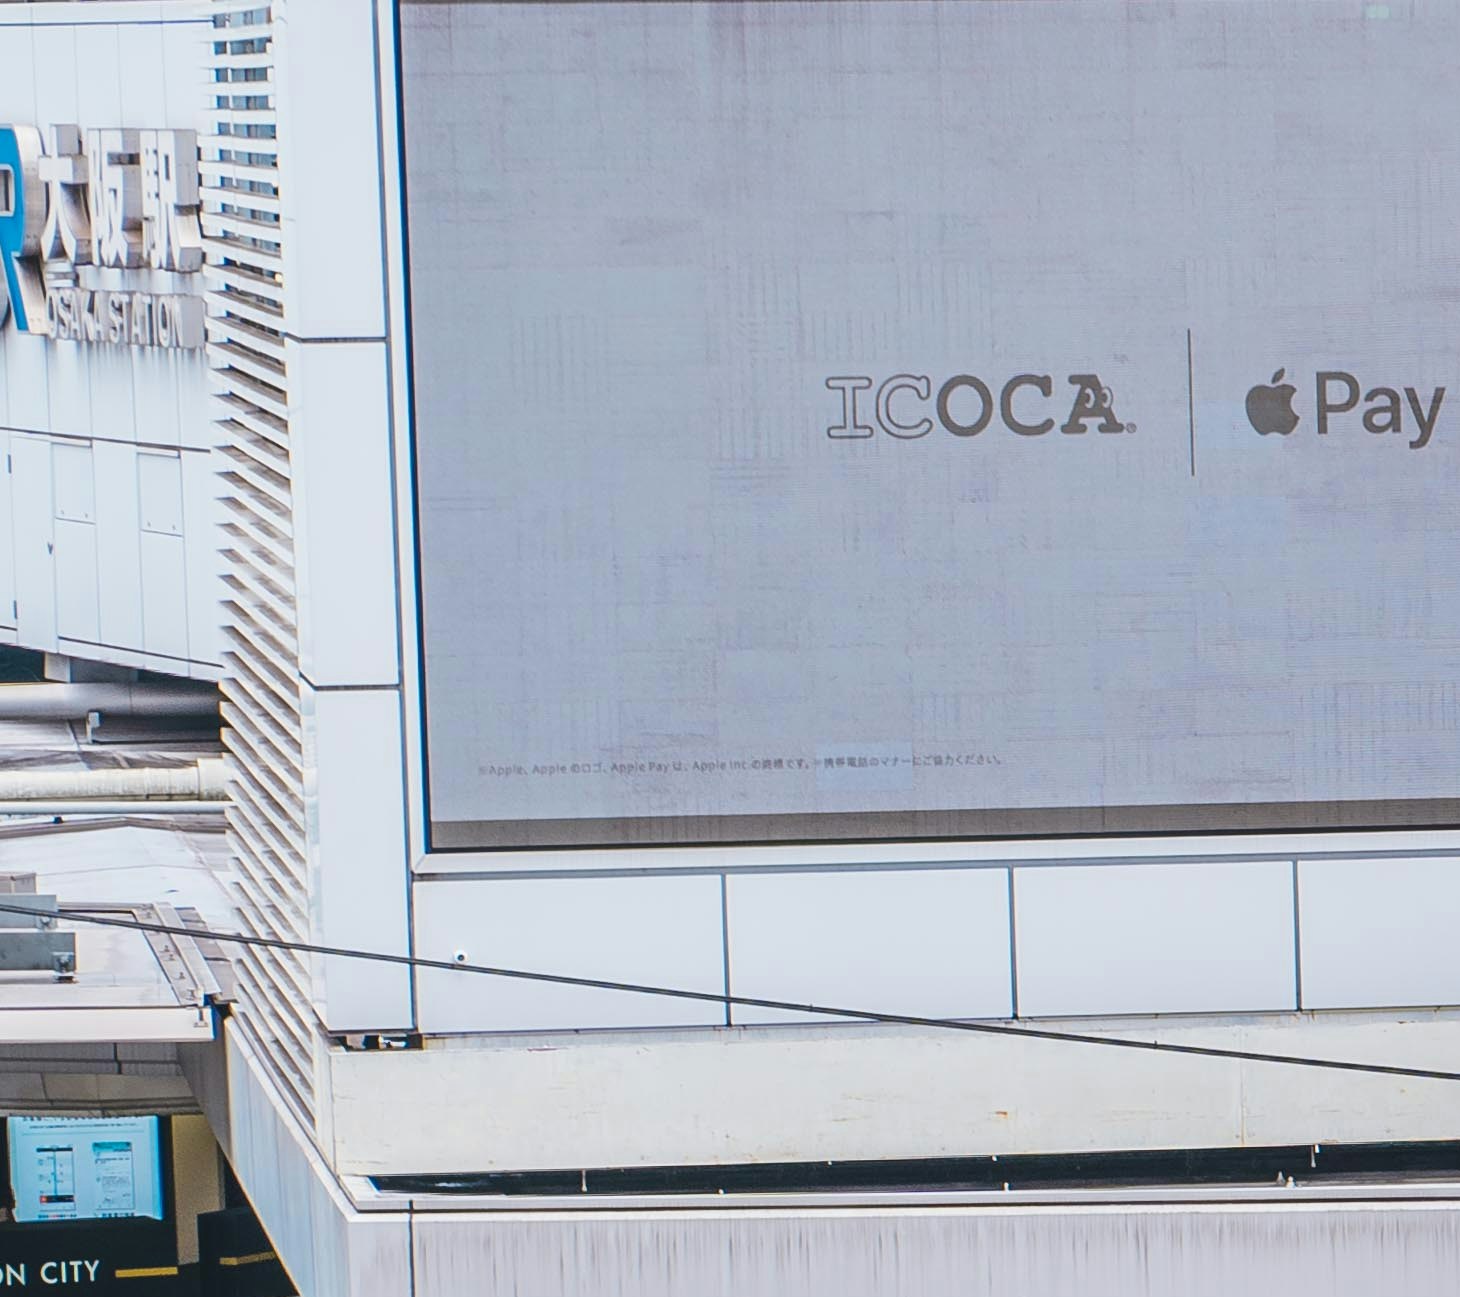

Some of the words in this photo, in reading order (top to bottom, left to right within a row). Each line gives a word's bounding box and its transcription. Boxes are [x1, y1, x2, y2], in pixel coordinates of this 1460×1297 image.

[38, 124, 183, 271] 大阪駅
[109, 292, 184, 350] STATION
[825, 372, 1126, 439] ICOCA
[1314, 370, 1448, 450] Pay
[40, 1260, 100, 1284] CITY
